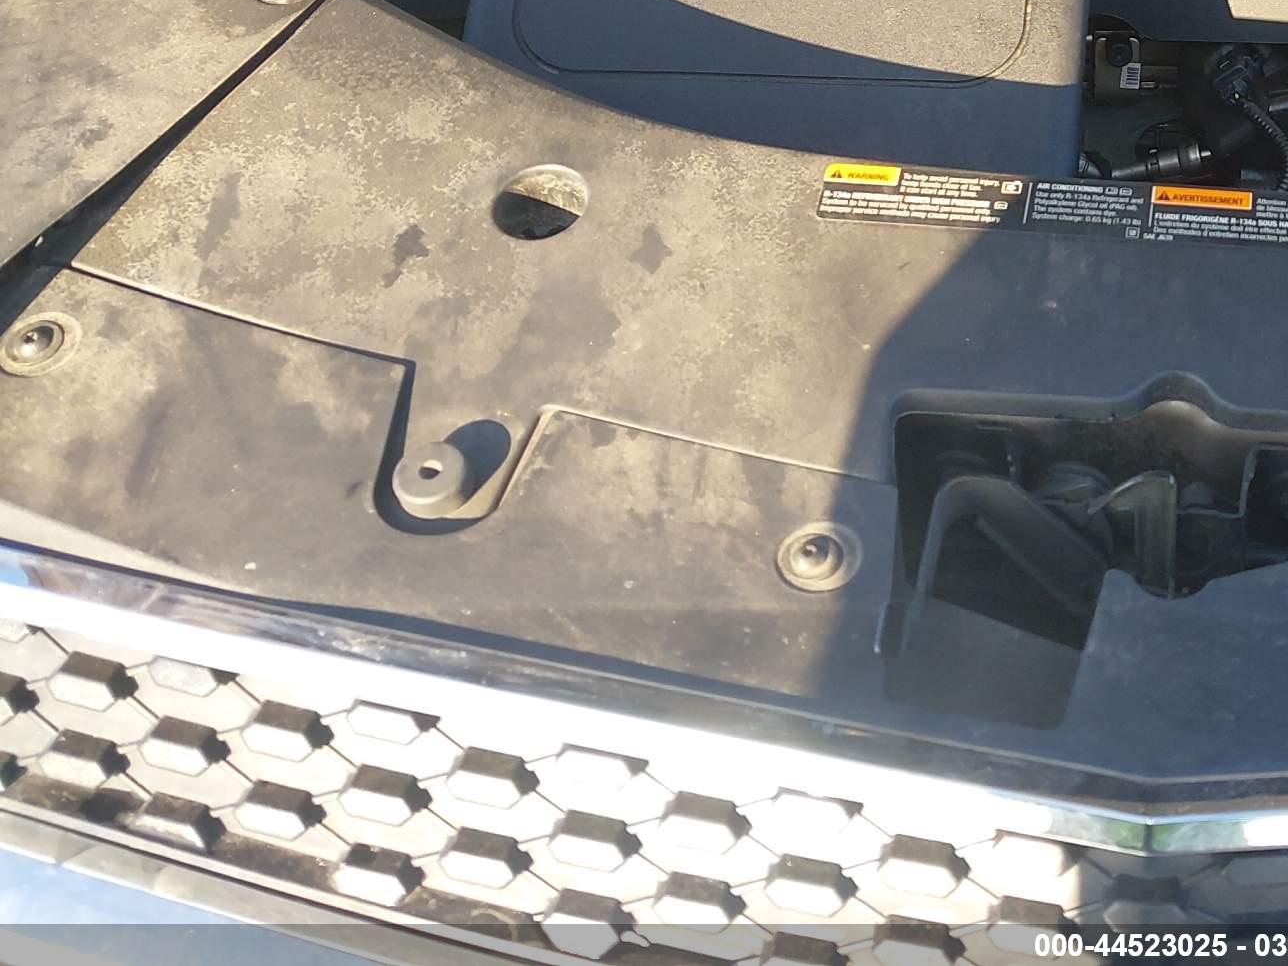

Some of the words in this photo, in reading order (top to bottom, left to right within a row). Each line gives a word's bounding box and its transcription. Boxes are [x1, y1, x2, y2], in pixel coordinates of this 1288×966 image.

[847, 172, 888, 181] WARNING
[1052, 184, 1104, 193] CONDITIONING
[1172, 193, 1243, 205] AVERTISSEMENT
[1154, 212, 1180, 220] FLUIDE
[1230, 217, 1256, 226] R-134a
[1258, 218, 1278, 227] SOUS
